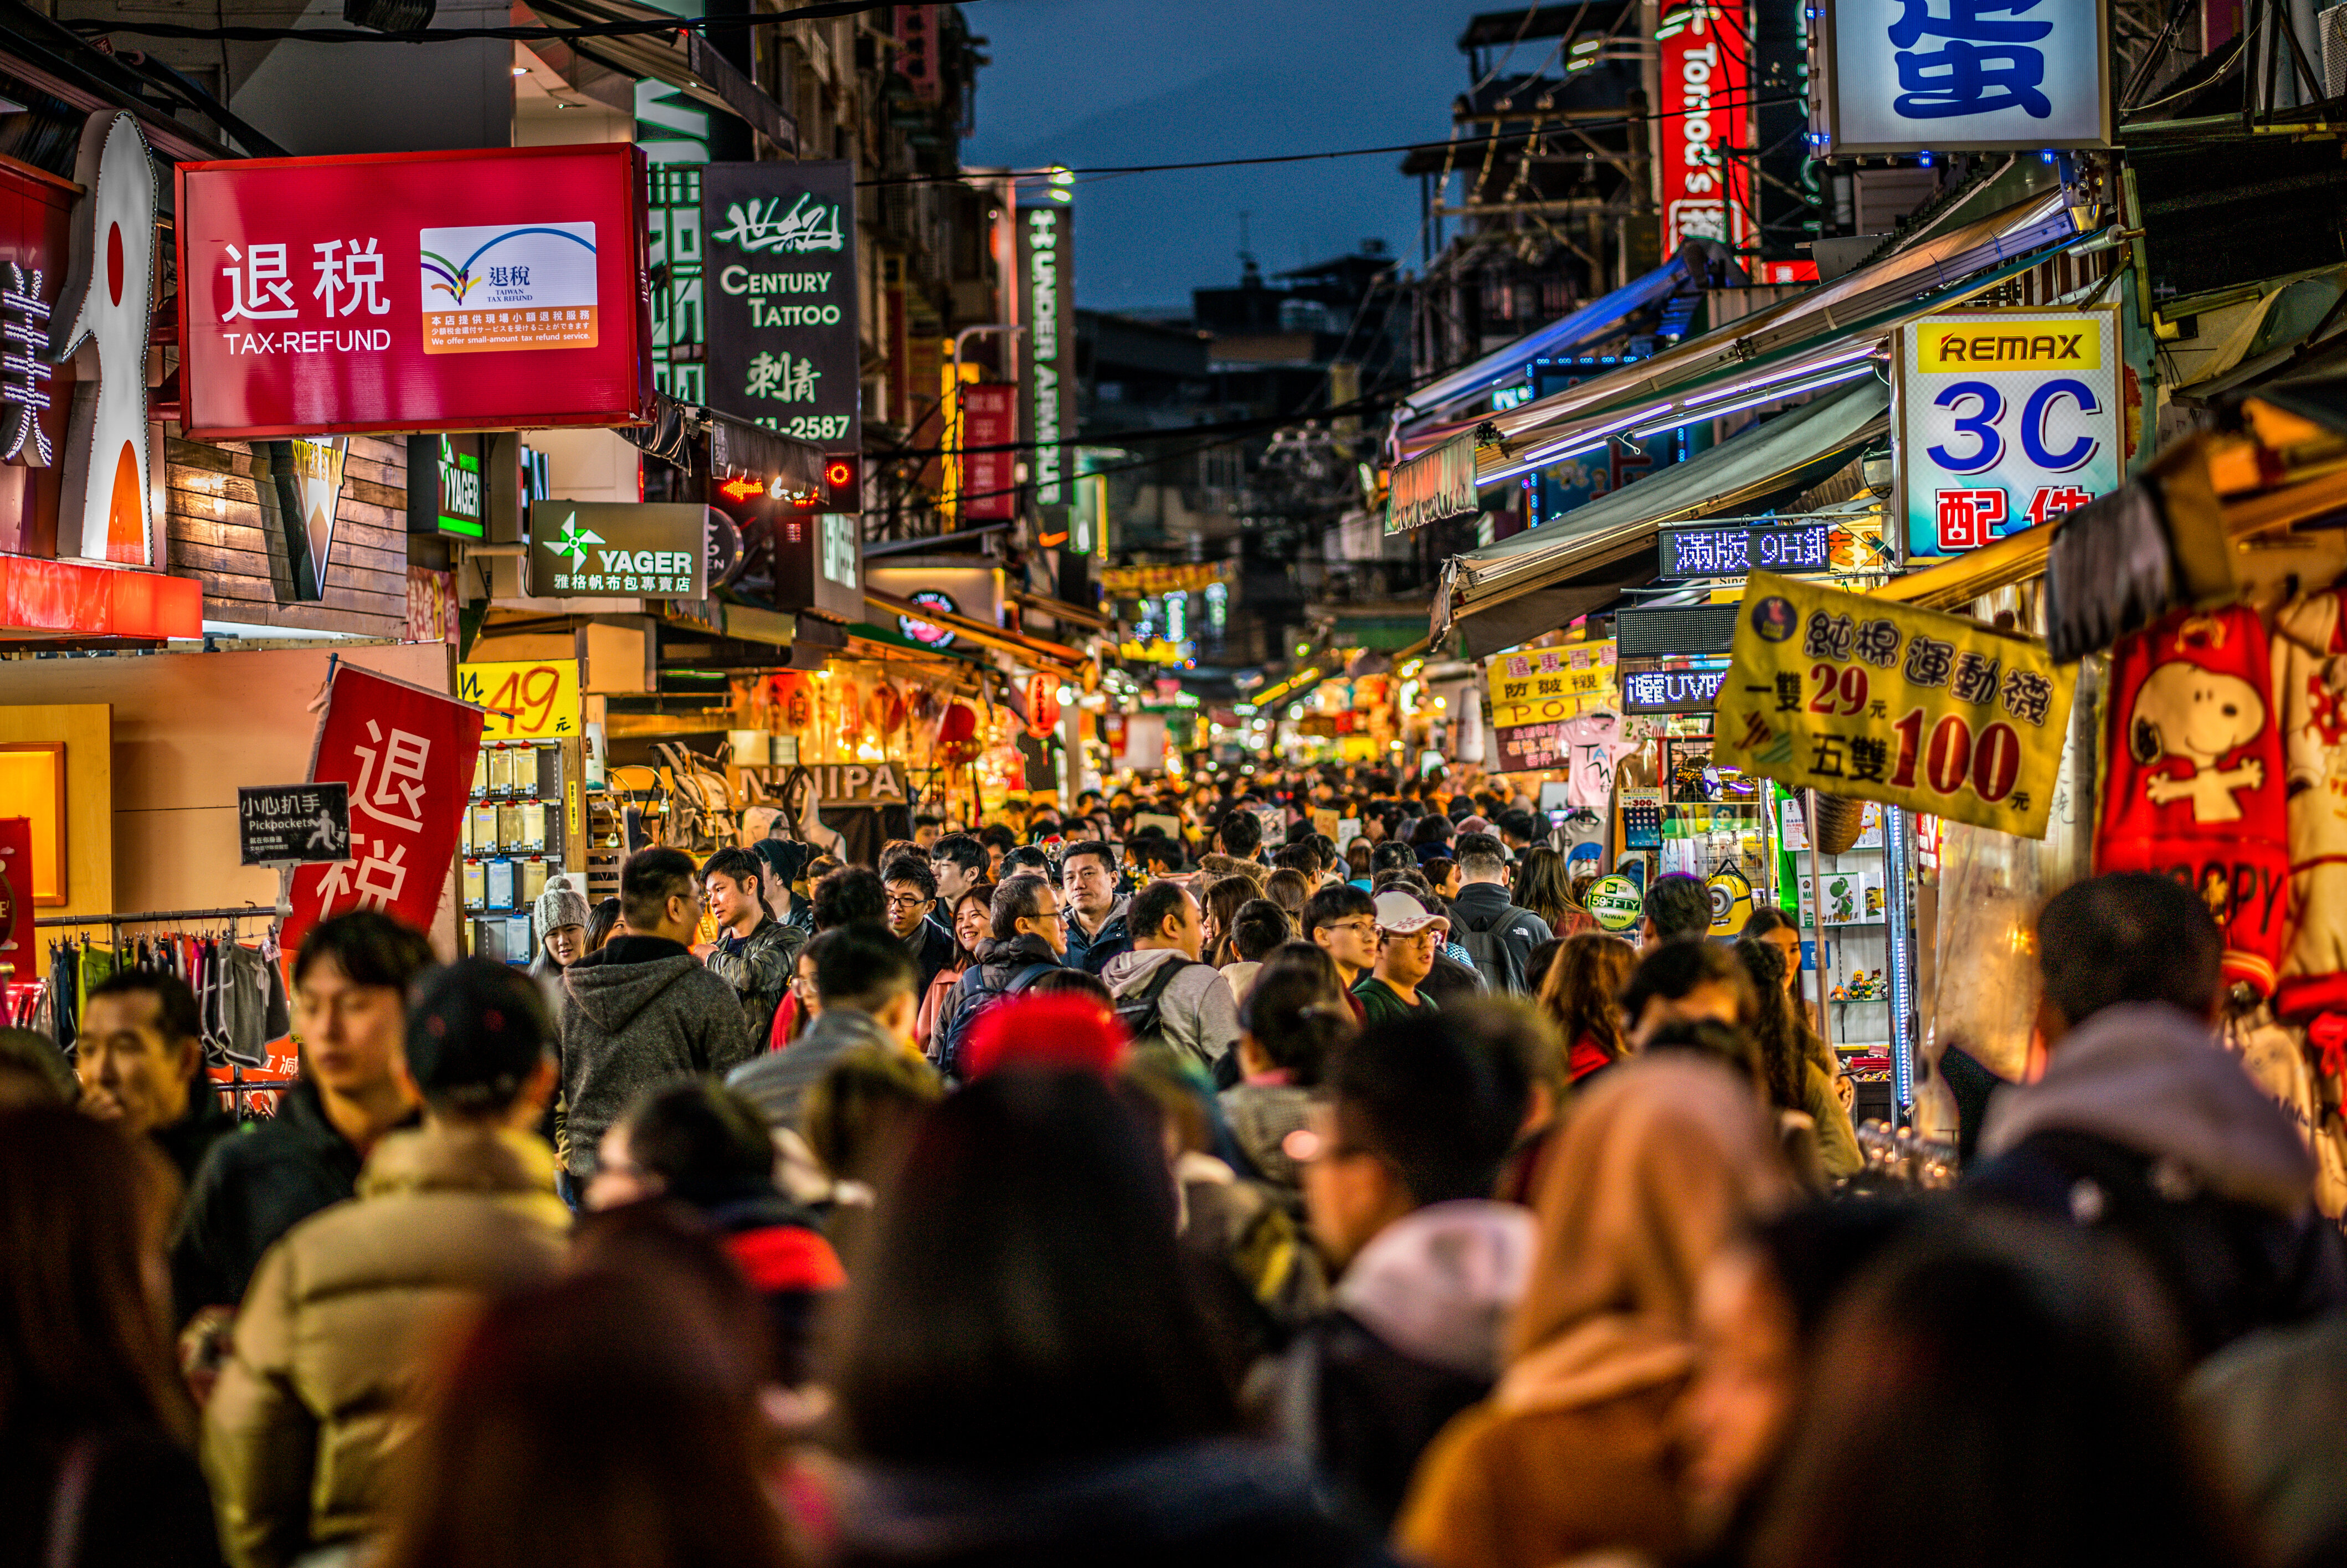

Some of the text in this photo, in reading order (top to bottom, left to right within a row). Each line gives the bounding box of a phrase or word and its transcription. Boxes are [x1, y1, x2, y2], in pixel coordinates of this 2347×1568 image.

[222, 237, 391, 322] 退税
[223, 329, 391, 354] TAX-REFUND
[1939, 332, 2083, 362] REMAX
[745, 351, 822, 403] 刺青
[1926, 378, 2103, 475] 3C
[293, 439, 343, 486] SUPER STAR
[450, 467, 480, 518] YAGER
[597, 550, 692, 574] YAGER
[554, 574, 691, 593] 雅格帆布包專賣店
[1719, 577, 1748, 585] Sinc
[242, 793, 320, 817] 小心扒手
[249, 818, 312, 831] Pickpockets
[1591, 896, 1639, 910] 59FIFTY
